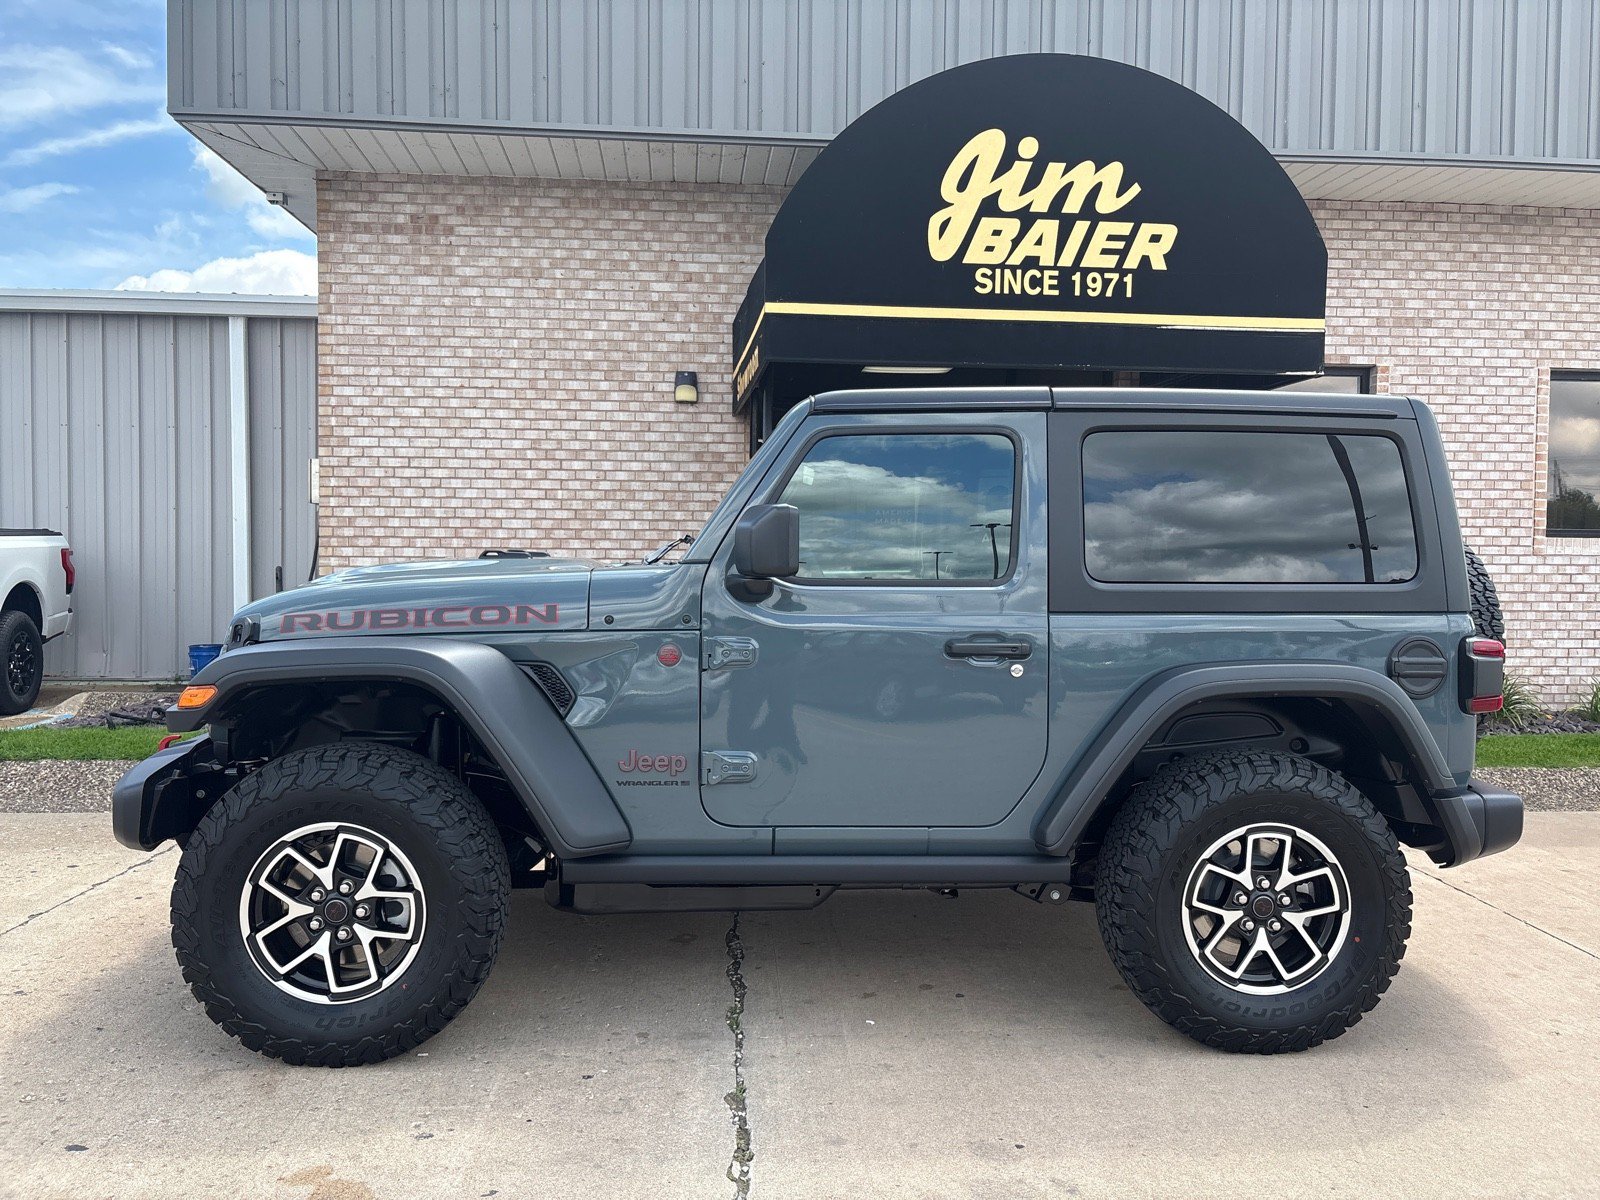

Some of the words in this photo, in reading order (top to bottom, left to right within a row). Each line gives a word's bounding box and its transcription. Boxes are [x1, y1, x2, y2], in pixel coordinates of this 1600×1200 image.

[928, 128, 1142, 262] Jim
[962, 217, 1178, 270] BAIER
[974, 268, 1060, 296] SINCE
[1071, 271, 1133, 298] 1971
[280, 603, 559, 633] RUBICON
[618, 749, 687, 777] Jeep
